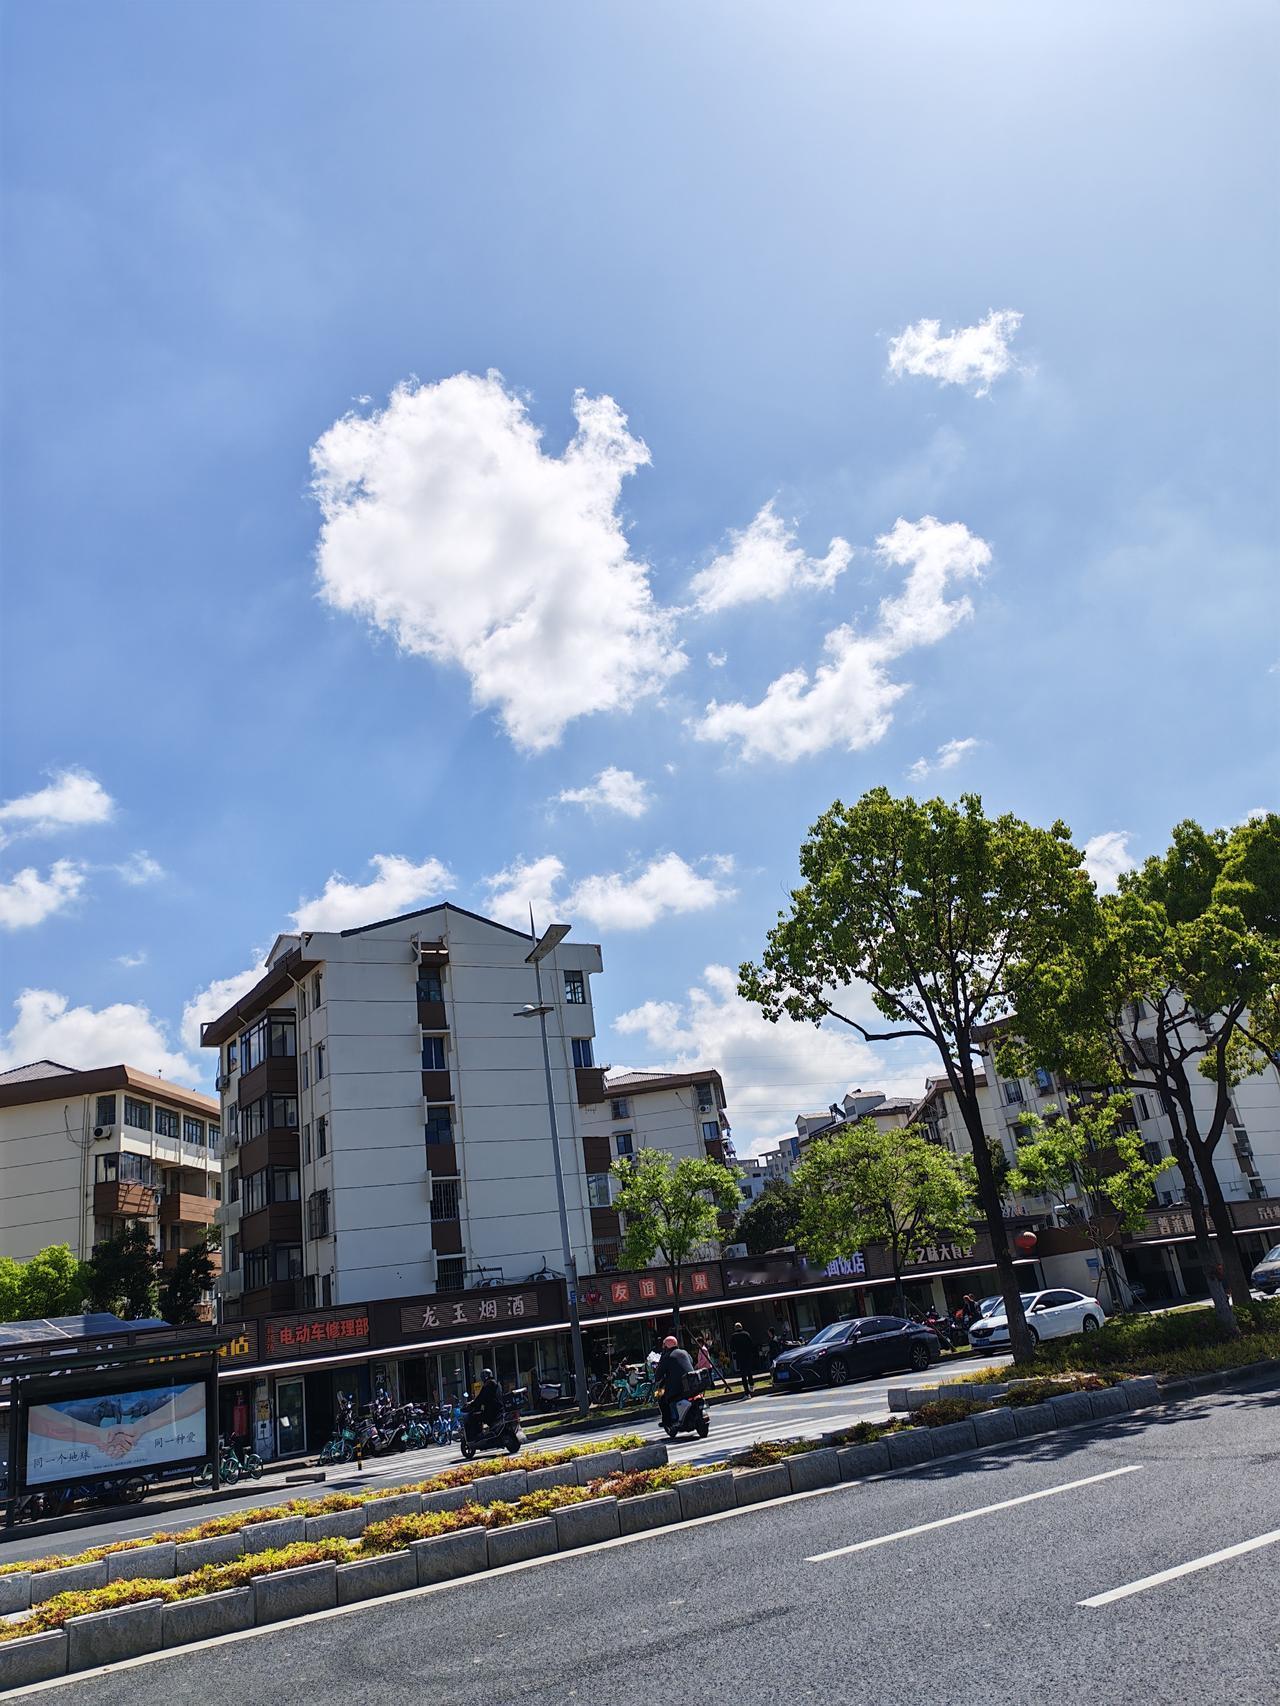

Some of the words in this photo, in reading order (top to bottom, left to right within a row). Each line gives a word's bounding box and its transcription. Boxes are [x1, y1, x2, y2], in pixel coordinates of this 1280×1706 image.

[904, 1241, 974, 1265] 之味大食堂
[422, 1294, 525, 1329] 龙玉烟酒
[280, 1317, 370, 1345] 电动车修理部
[154, 1431, 197, 1449] 同一种爱
[33, 1449, 91, 1469] 同一个地球
